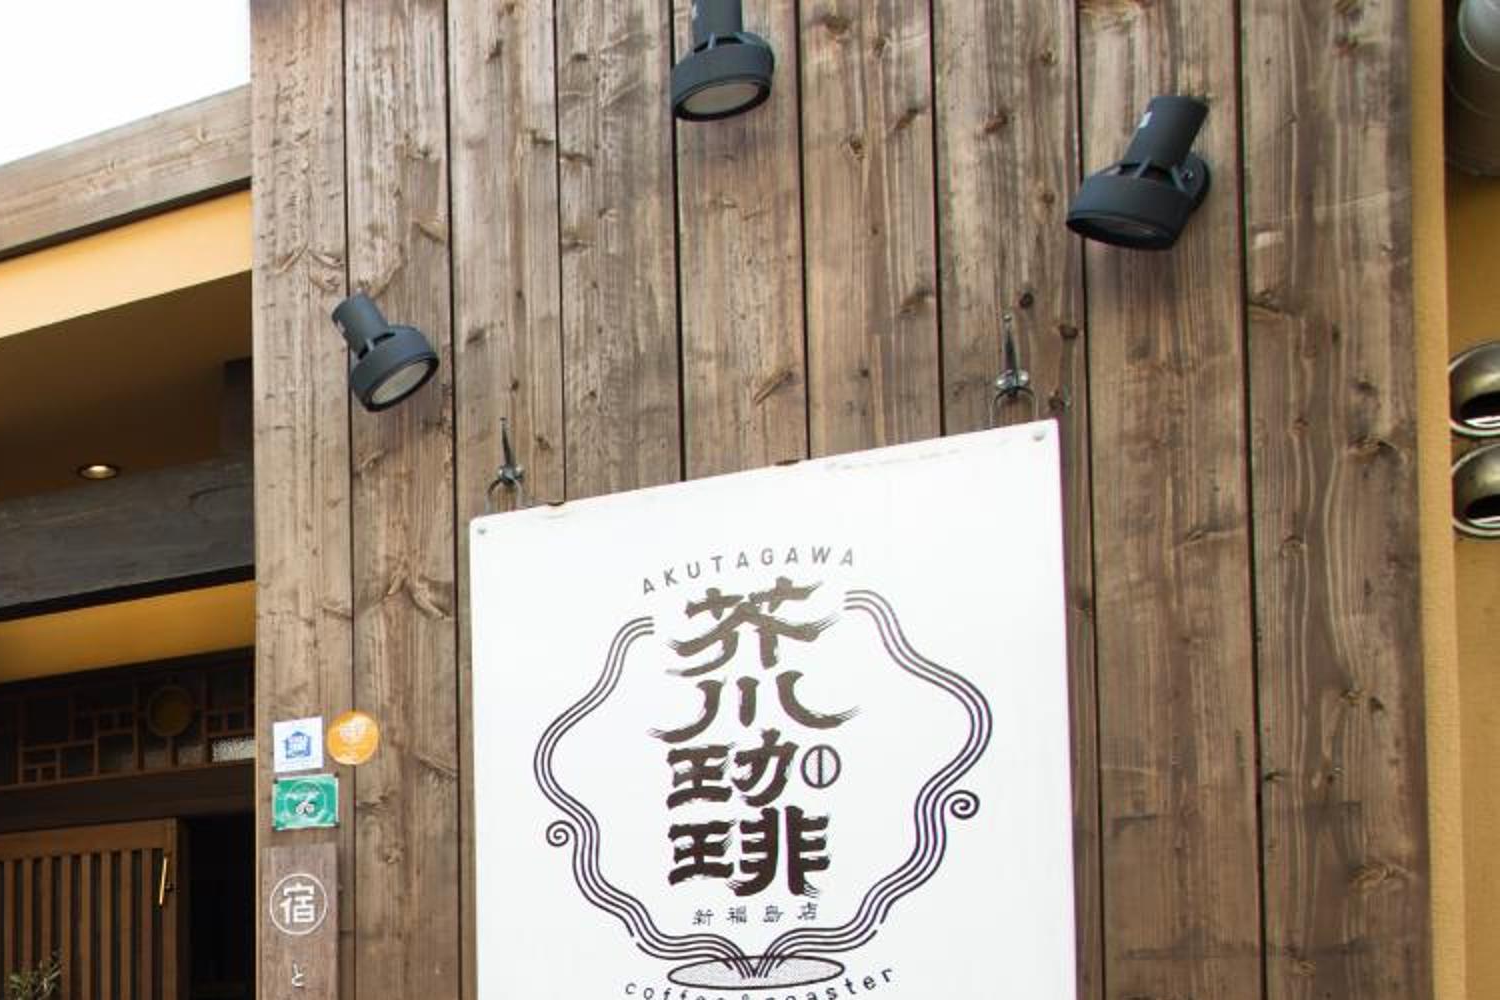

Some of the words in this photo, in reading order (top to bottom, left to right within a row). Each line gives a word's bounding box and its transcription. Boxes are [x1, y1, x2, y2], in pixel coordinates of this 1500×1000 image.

[642, 545, 856, 595] AKUTAGAWA
[647, 576, 860, 898] 芥川珈琲
[692, 902, 818, 926] 新福島店
